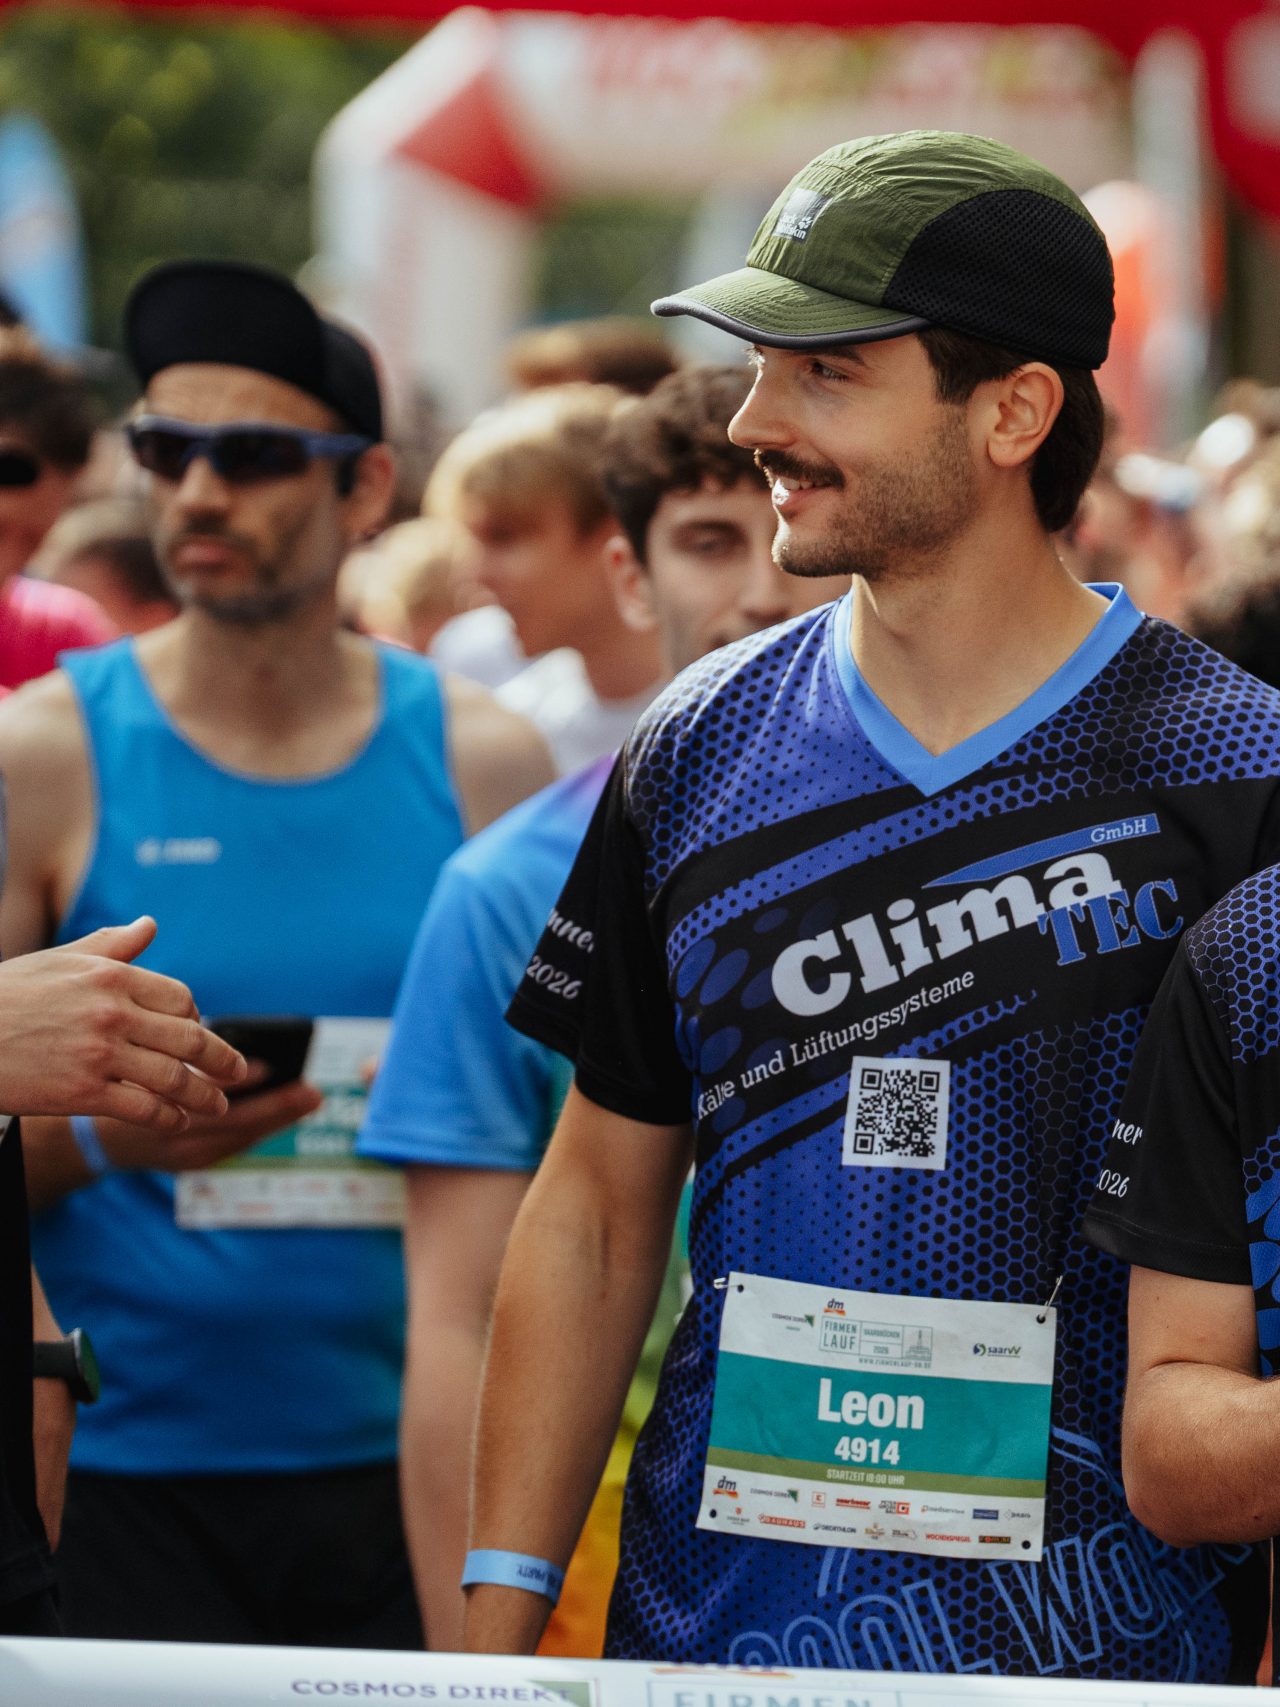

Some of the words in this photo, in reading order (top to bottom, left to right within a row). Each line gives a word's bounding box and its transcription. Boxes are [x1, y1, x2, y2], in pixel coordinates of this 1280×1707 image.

[1090, 818, 1148, 844] GmbH
[771, 851, 1122, 1017] Clima
[1037, 878, 1184, 966] TEC
[526, 954, 583, 1000] 2026
[740, 1050, 786, 1089] und
[789, 970, 976, 1067] Lüftungssysteme
[1096, 1169, 1131, 1198] 026
[827, 1298, 845, 1310] dm
[824, 1320, 857, 1334] FIRMEN
[823, 1333, 857, 1350] LAUF
[817, 1377, 925, 1430] Leon
[834, 1436, 900, 1466] 4914
[717, 1475, 737, 1490] dm
[826, 1468, 865, 1482] STARTZEIT
[888, 1474, 905, 1486] UHR
[291, 1679, 438, 1699] COSMOS
